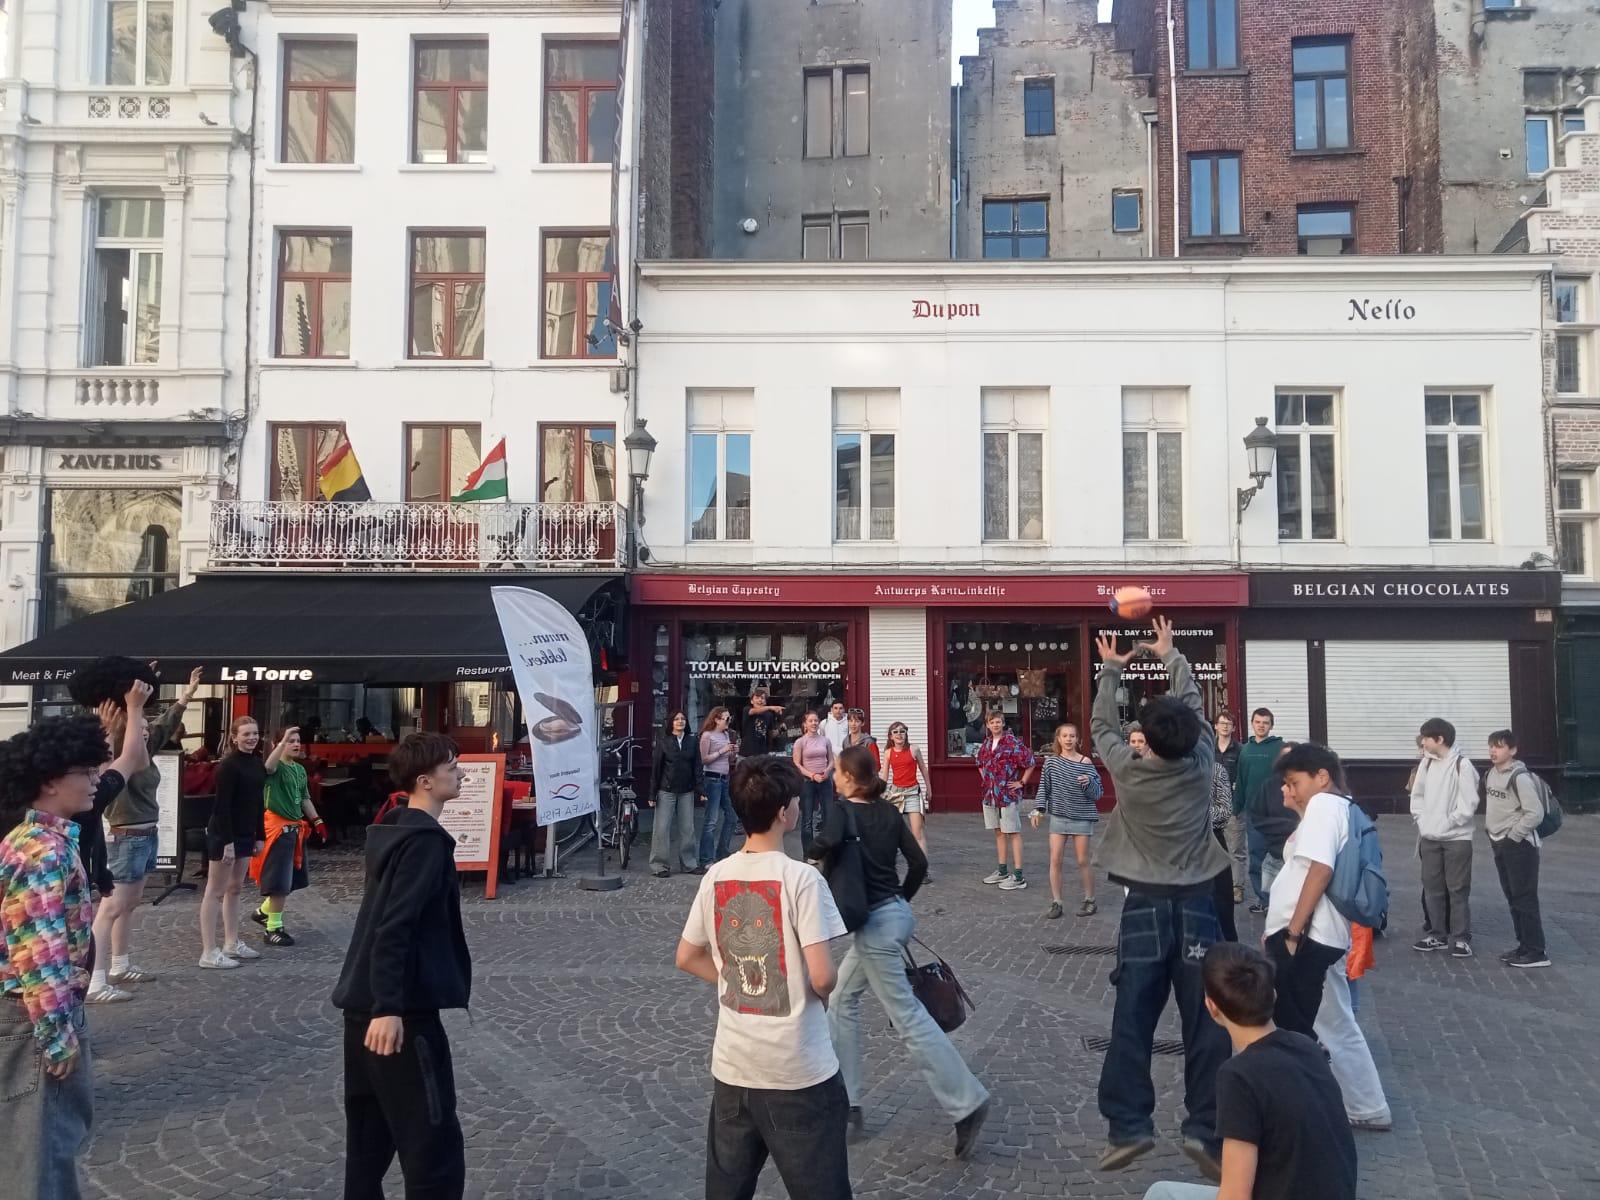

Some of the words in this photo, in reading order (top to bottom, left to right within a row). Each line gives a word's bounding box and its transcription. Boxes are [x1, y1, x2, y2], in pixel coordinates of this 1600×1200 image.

[912, 300, 980, 320] Dupon
[1348, 299, 1416, 320] Nello
[59, 455, 162, 470] XAVERIUS
[688, 584, 728, 596] Belgian
[732, 584, 781, 597] Tapestry
[874, 585, 927, 597] Antwerps
[1293, 583, 1375, 596] BELGIAN
[1384, 583, 1510, 596] CHOCOLATES
[456, 665, 512, 676] Restauran
[690, 661, 743, 672] TOTALE
[747, 661, 840, 672] UITVERKOOP
[1194, 663, 1222, 671] SALE
[12, 670, 40, 680] Meat
[43, 669, 52, 680] &
[55, 669, 76, 680] Fis
[221, 667, 248, 681] La
[253, 667, 313, 681] Torre
